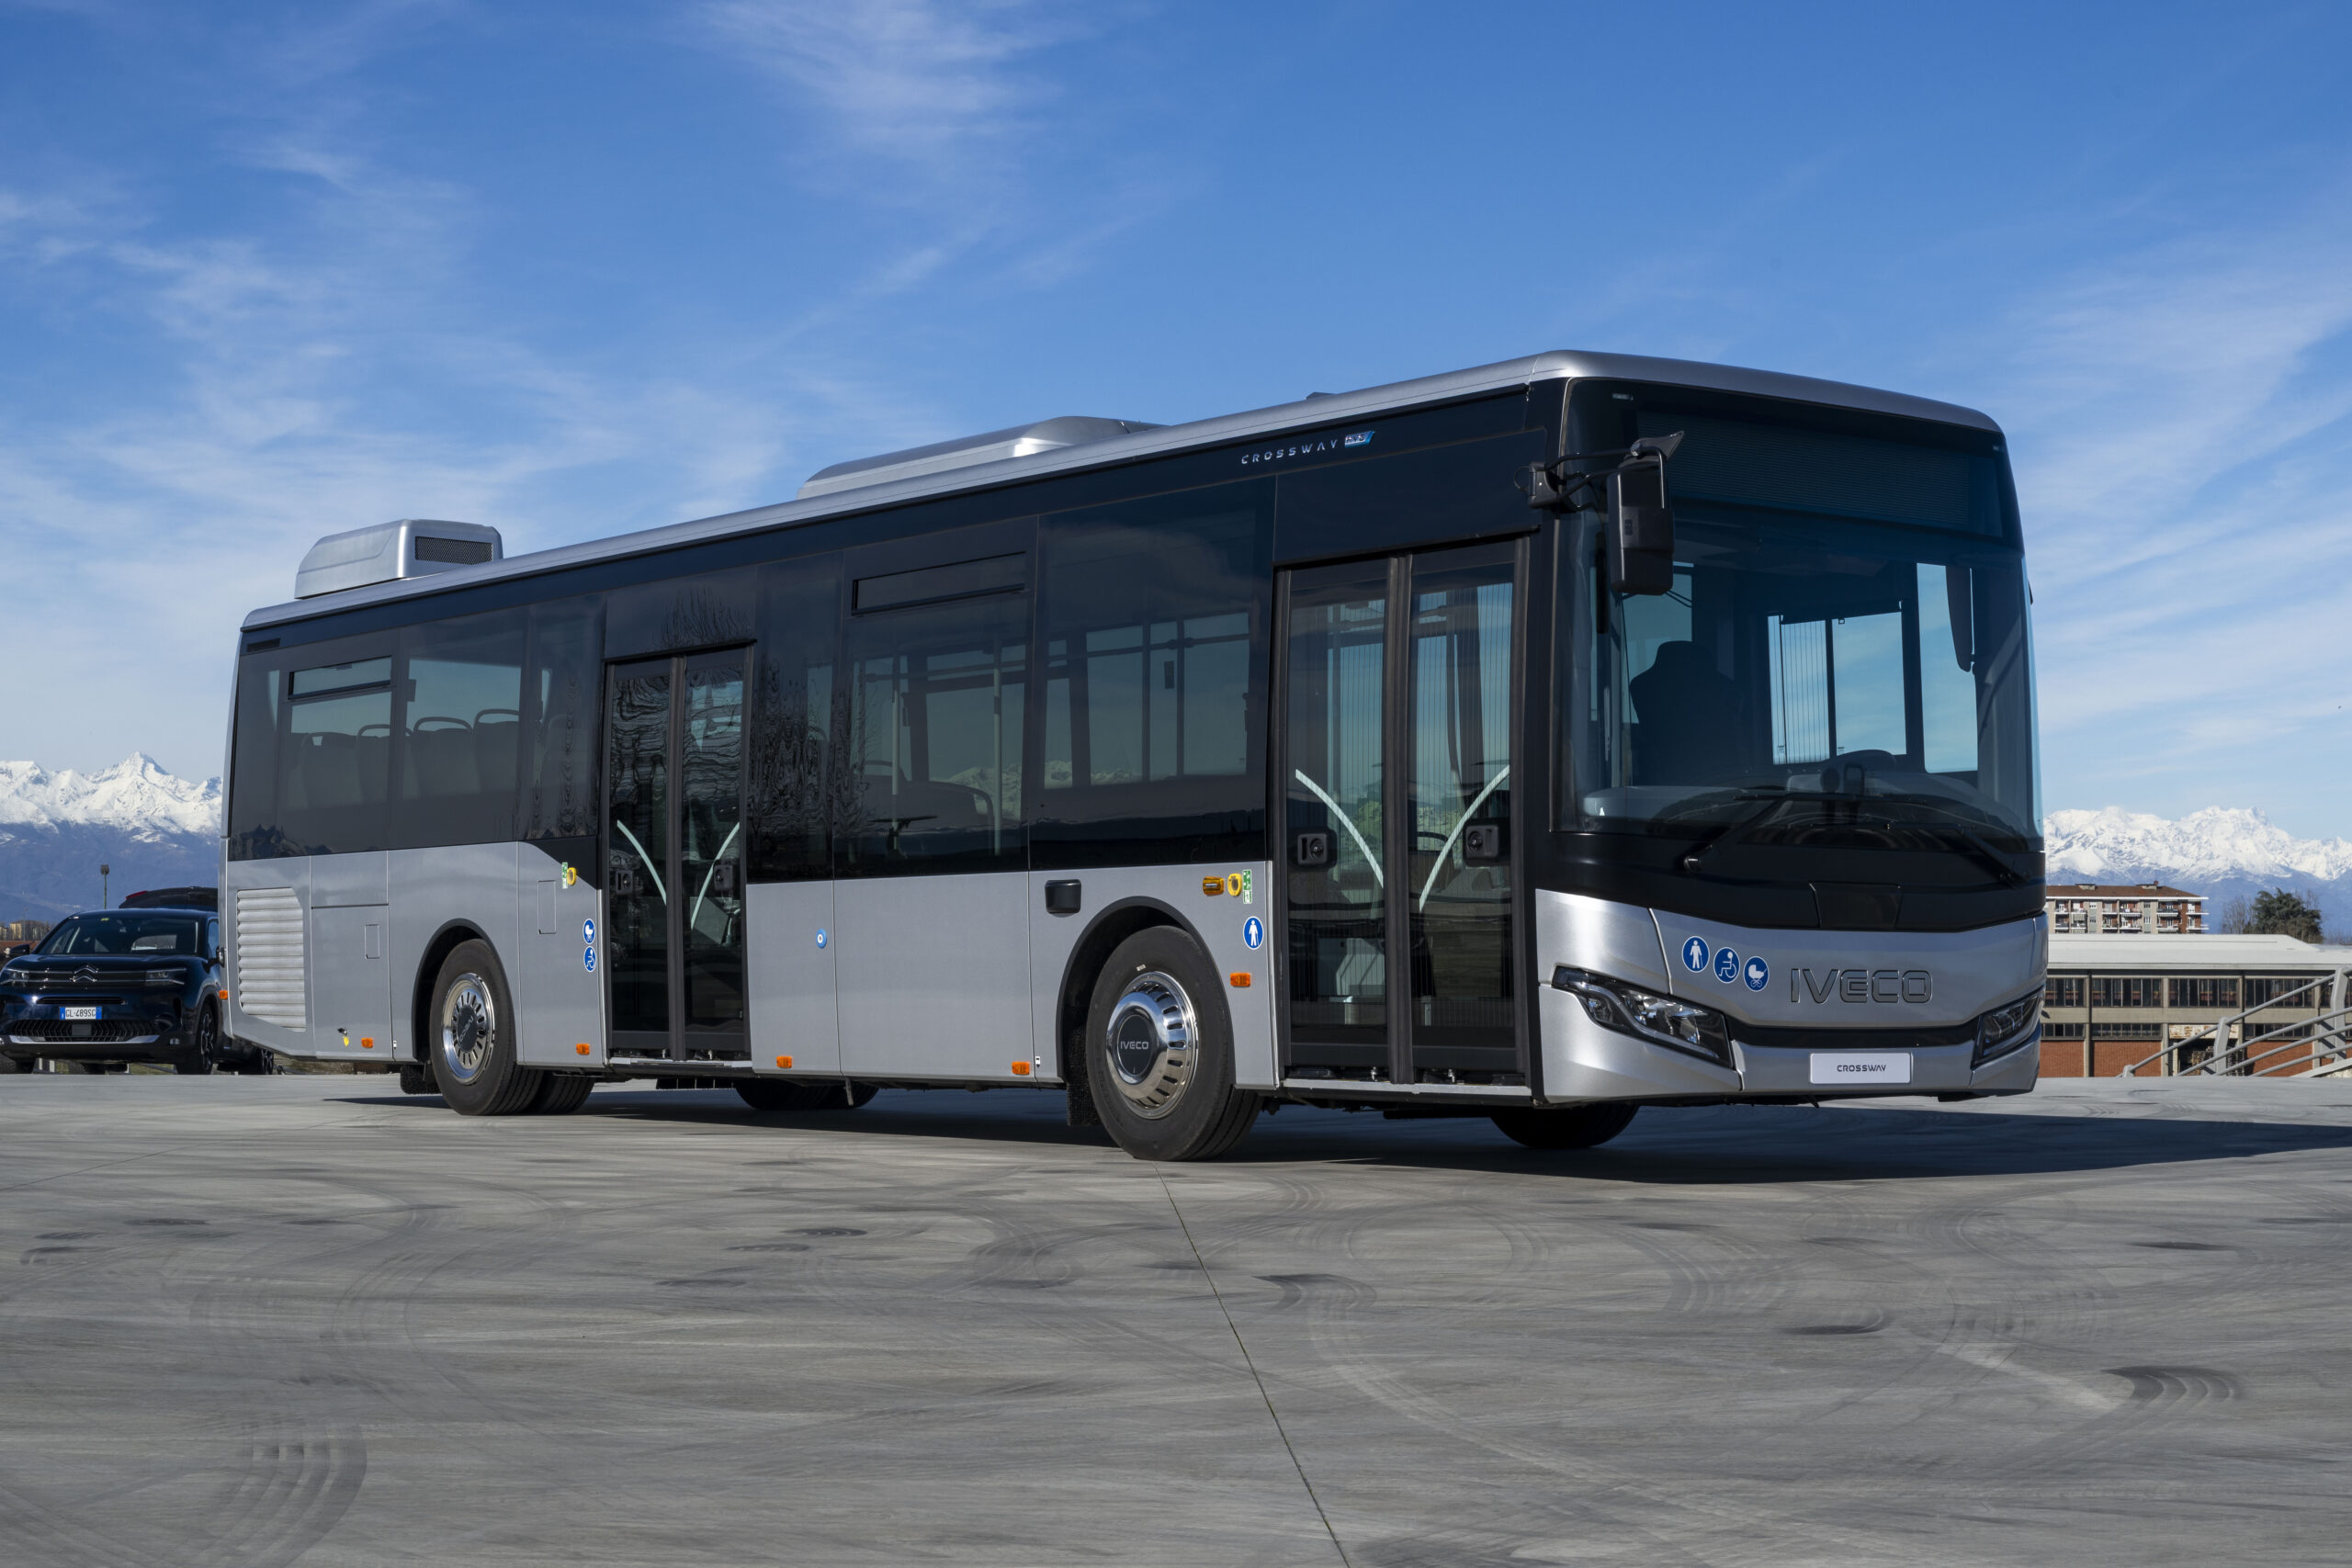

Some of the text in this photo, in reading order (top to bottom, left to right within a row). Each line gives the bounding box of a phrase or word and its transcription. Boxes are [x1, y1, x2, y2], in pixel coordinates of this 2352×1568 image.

[1241, 439, 1338, 464] CROSSWAY
[1791, 968, 1933, 1004] IVECO
[1120, 1041, 1149, 1050] IVECO
[1837, 1065, 1887, 1073] CROSSWAY
